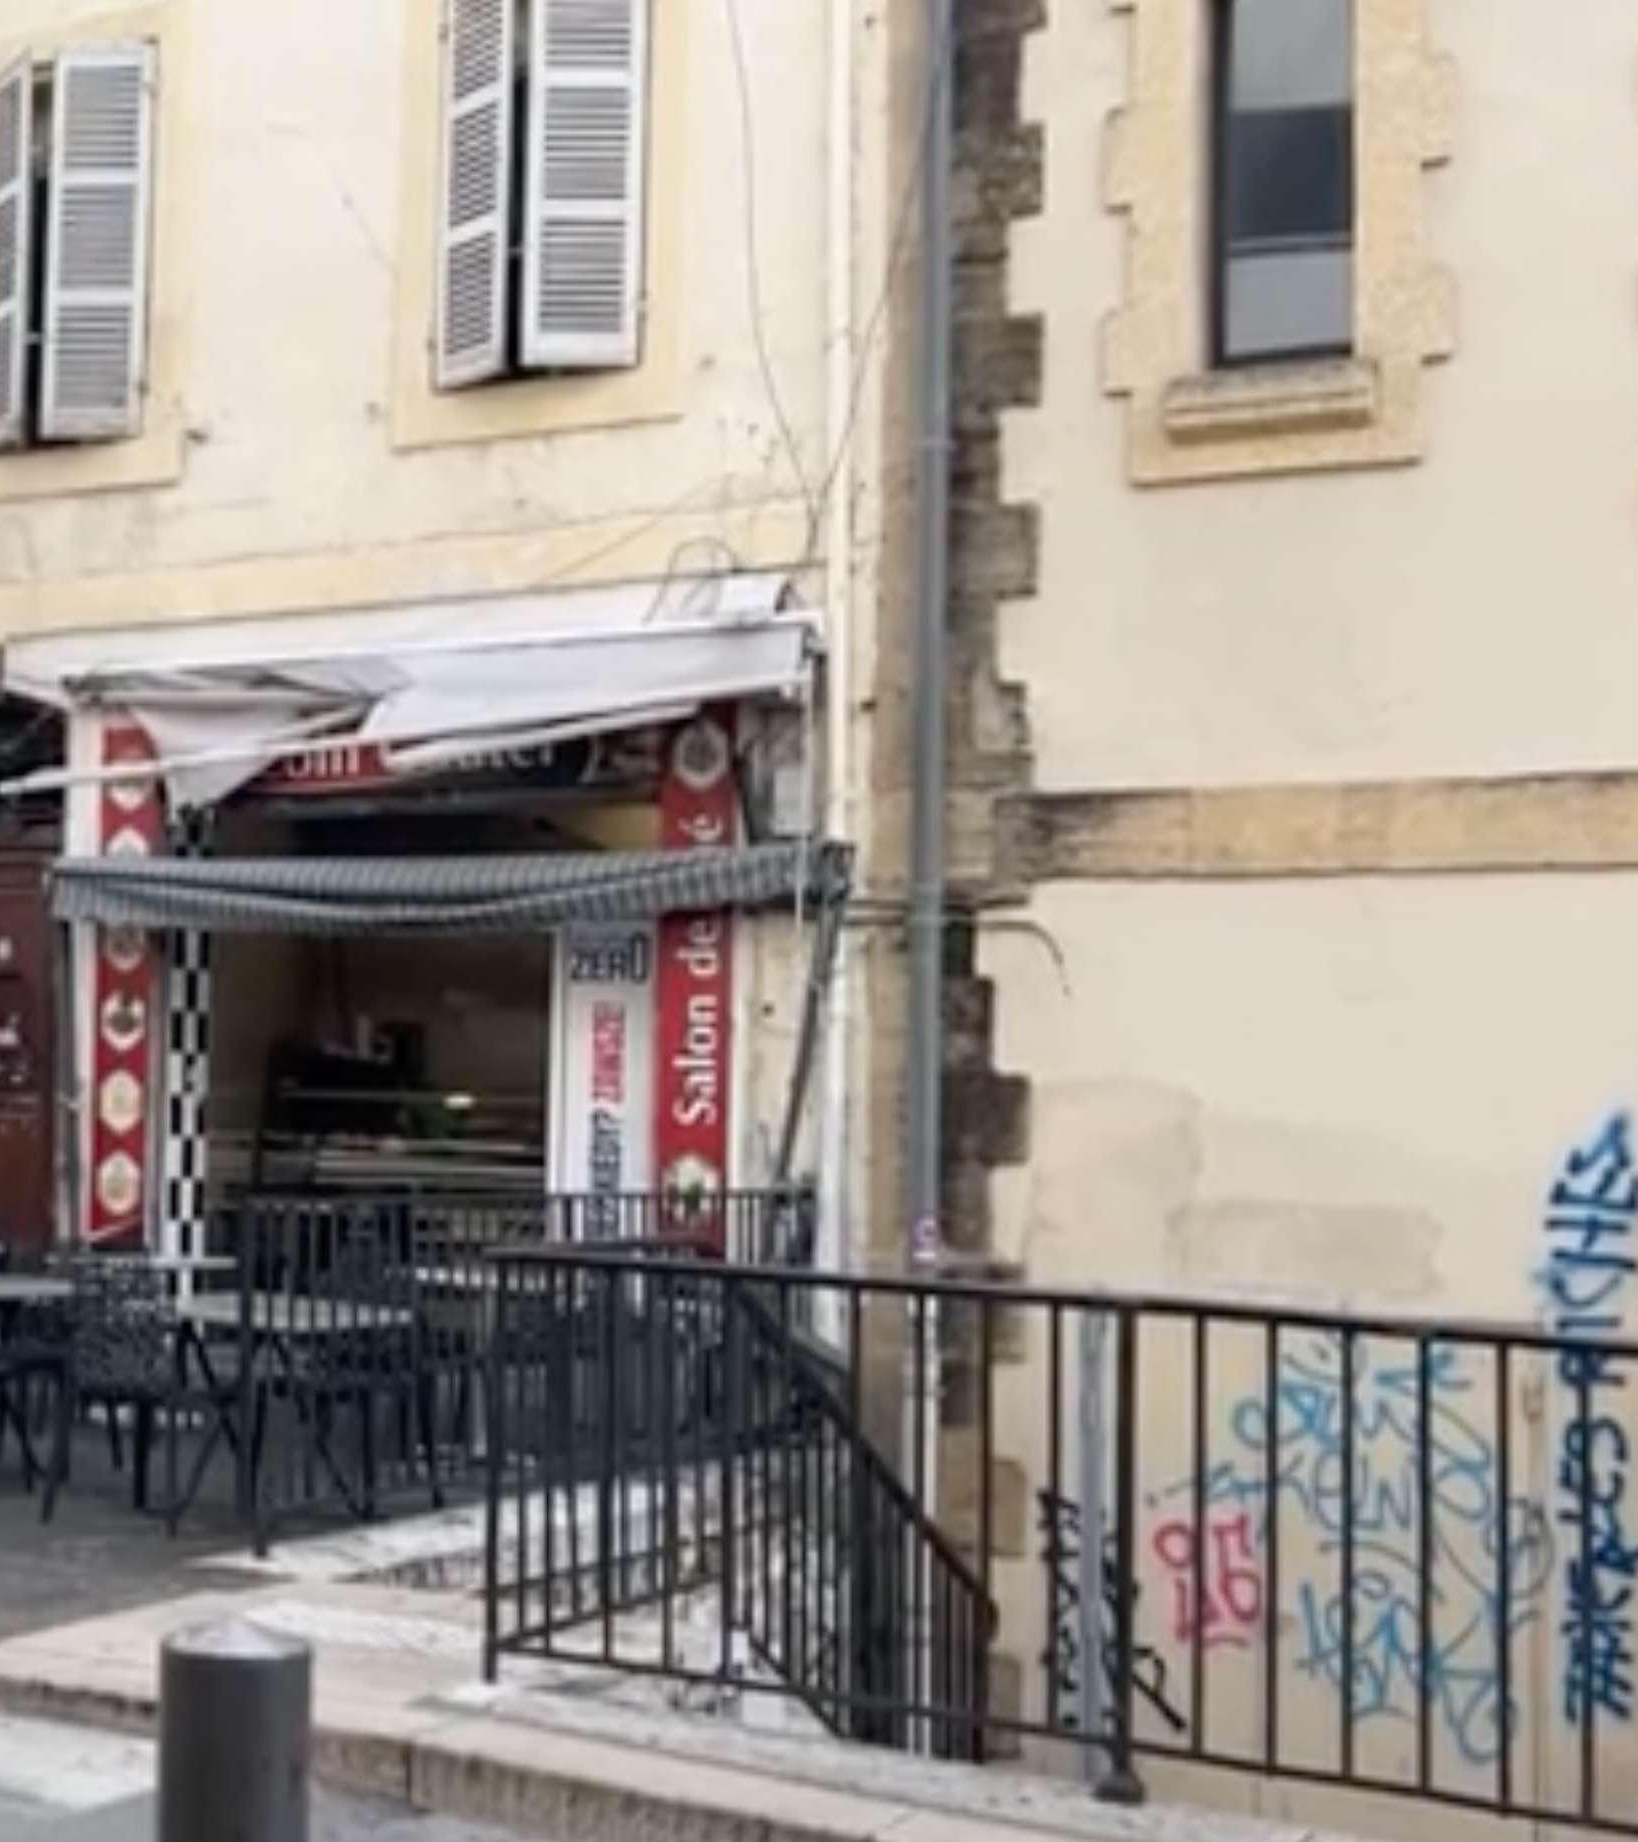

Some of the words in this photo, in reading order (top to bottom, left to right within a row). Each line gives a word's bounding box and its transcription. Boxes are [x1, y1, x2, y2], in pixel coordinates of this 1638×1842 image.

[570, 931, 649, 985] ZERO
[677, 916, 719, 977] de
[673, 994, 719, 1126] Salon
